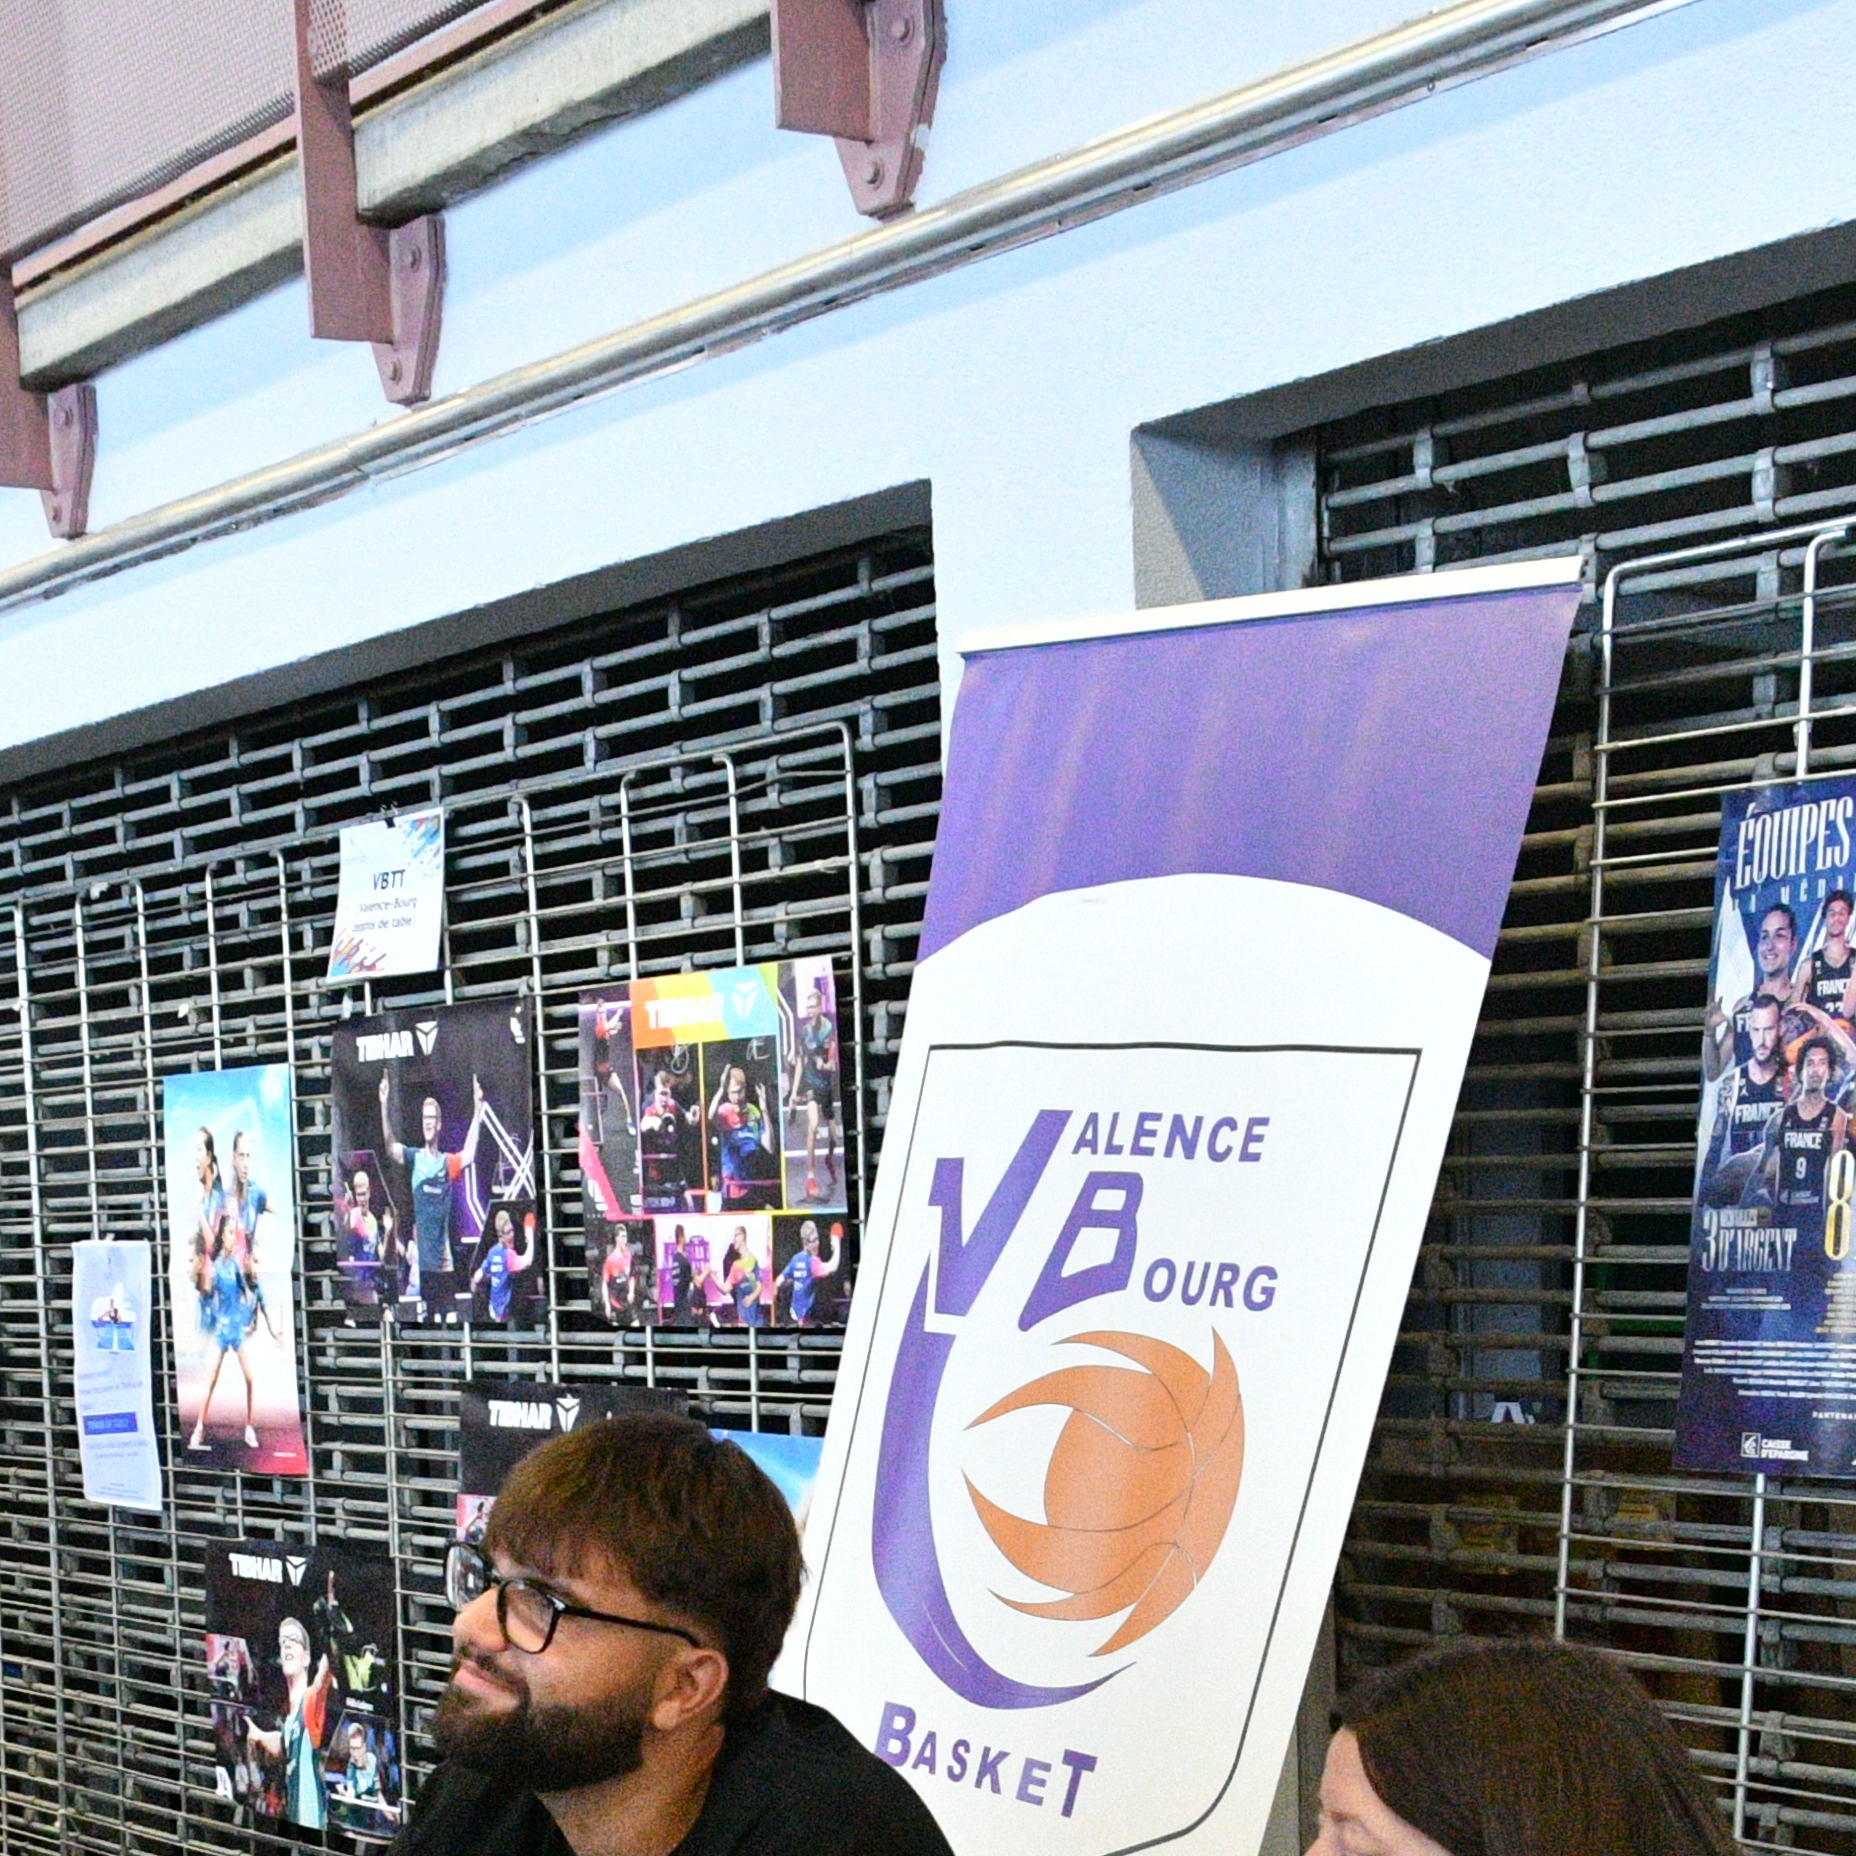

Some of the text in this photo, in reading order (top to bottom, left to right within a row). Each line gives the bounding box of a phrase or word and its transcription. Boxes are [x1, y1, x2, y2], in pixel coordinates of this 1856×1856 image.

[373, 869, 406, 891] VBTT
[1817, 977, 1851, 998] FRANC
[356, 1030, 416, 1062] TIBHAR
[1795, 1157, 1807, 1179] 9
[1824, 1150, 1855, 1261] 8
[487, 1400, 553, 1431] TIBHAR
[228, 1552, 284, 1584] TIBHAR
[874, 1702, 1098, 1818] BASKET
